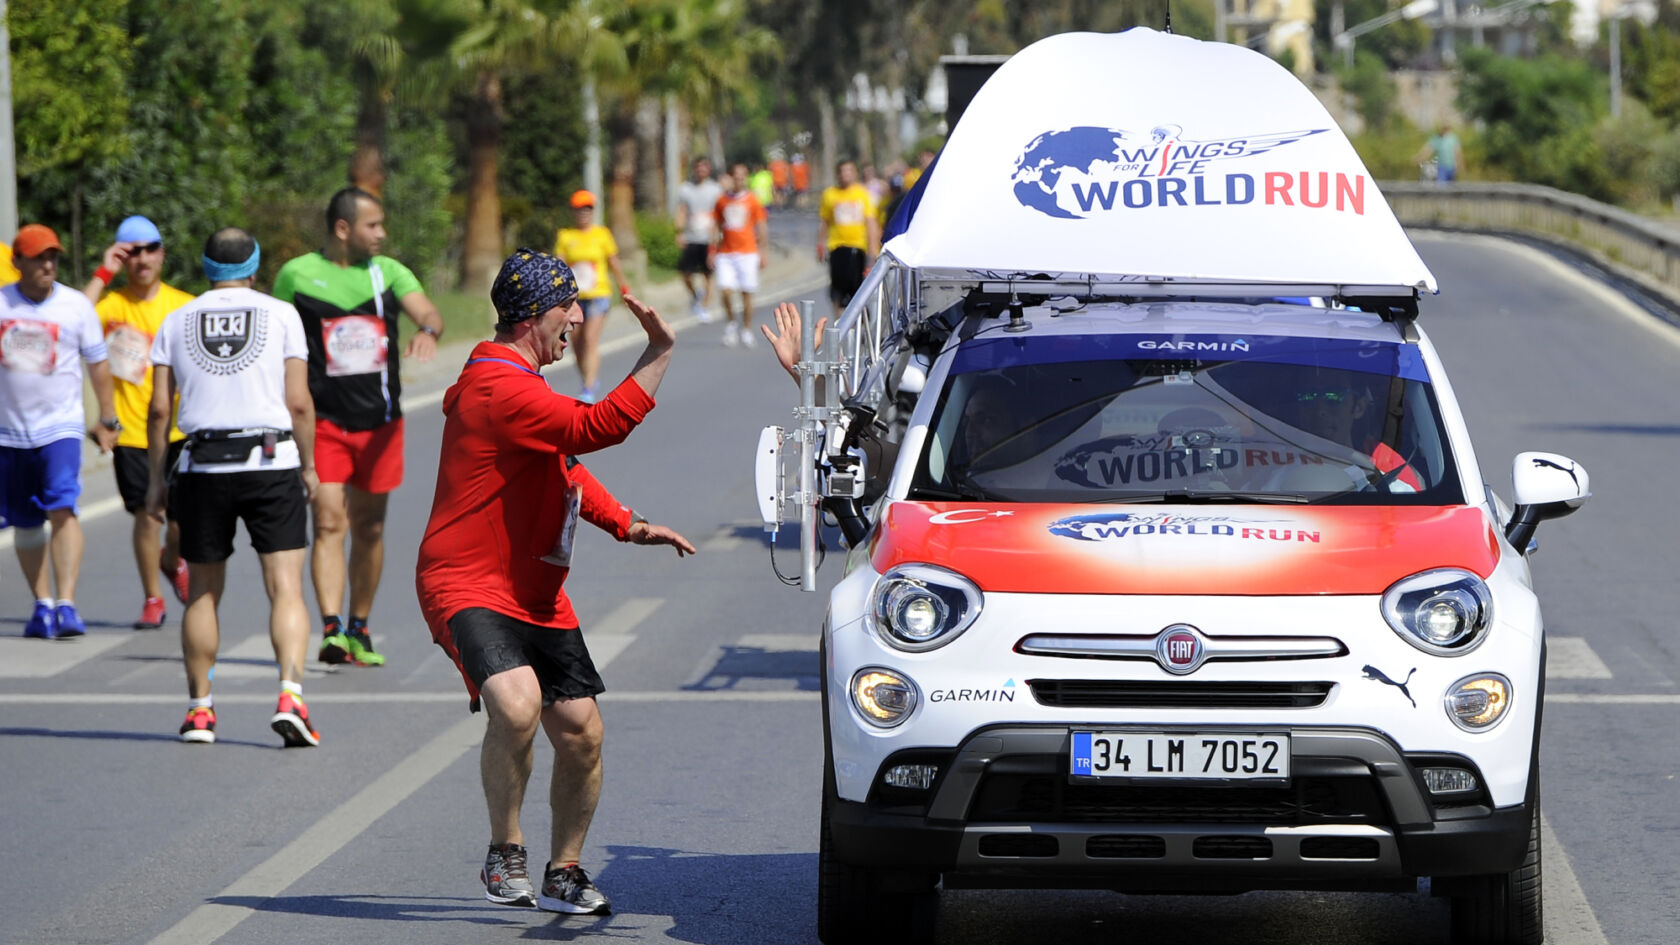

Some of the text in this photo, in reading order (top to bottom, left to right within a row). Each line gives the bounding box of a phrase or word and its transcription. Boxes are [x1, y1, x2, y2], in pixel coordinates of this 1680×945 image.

[1121, 140, 1248, 164] WINGS
[1113, 158, 1213, 177] FOR LIFE
[1072, 171, 1365, 216] WORLD RUN
[1137, 340, 1249, 352] GARMIN
[1098, 448, 1324, 485] WORLD RUN
[1095, 524, 1321, 543] WORLD RUN
[1170, 640, 1194, 659] FIAT
[930, 689, 1015, 703] GARMIN
[1076, 738, 1279, 774] TR 34 LM 7052
